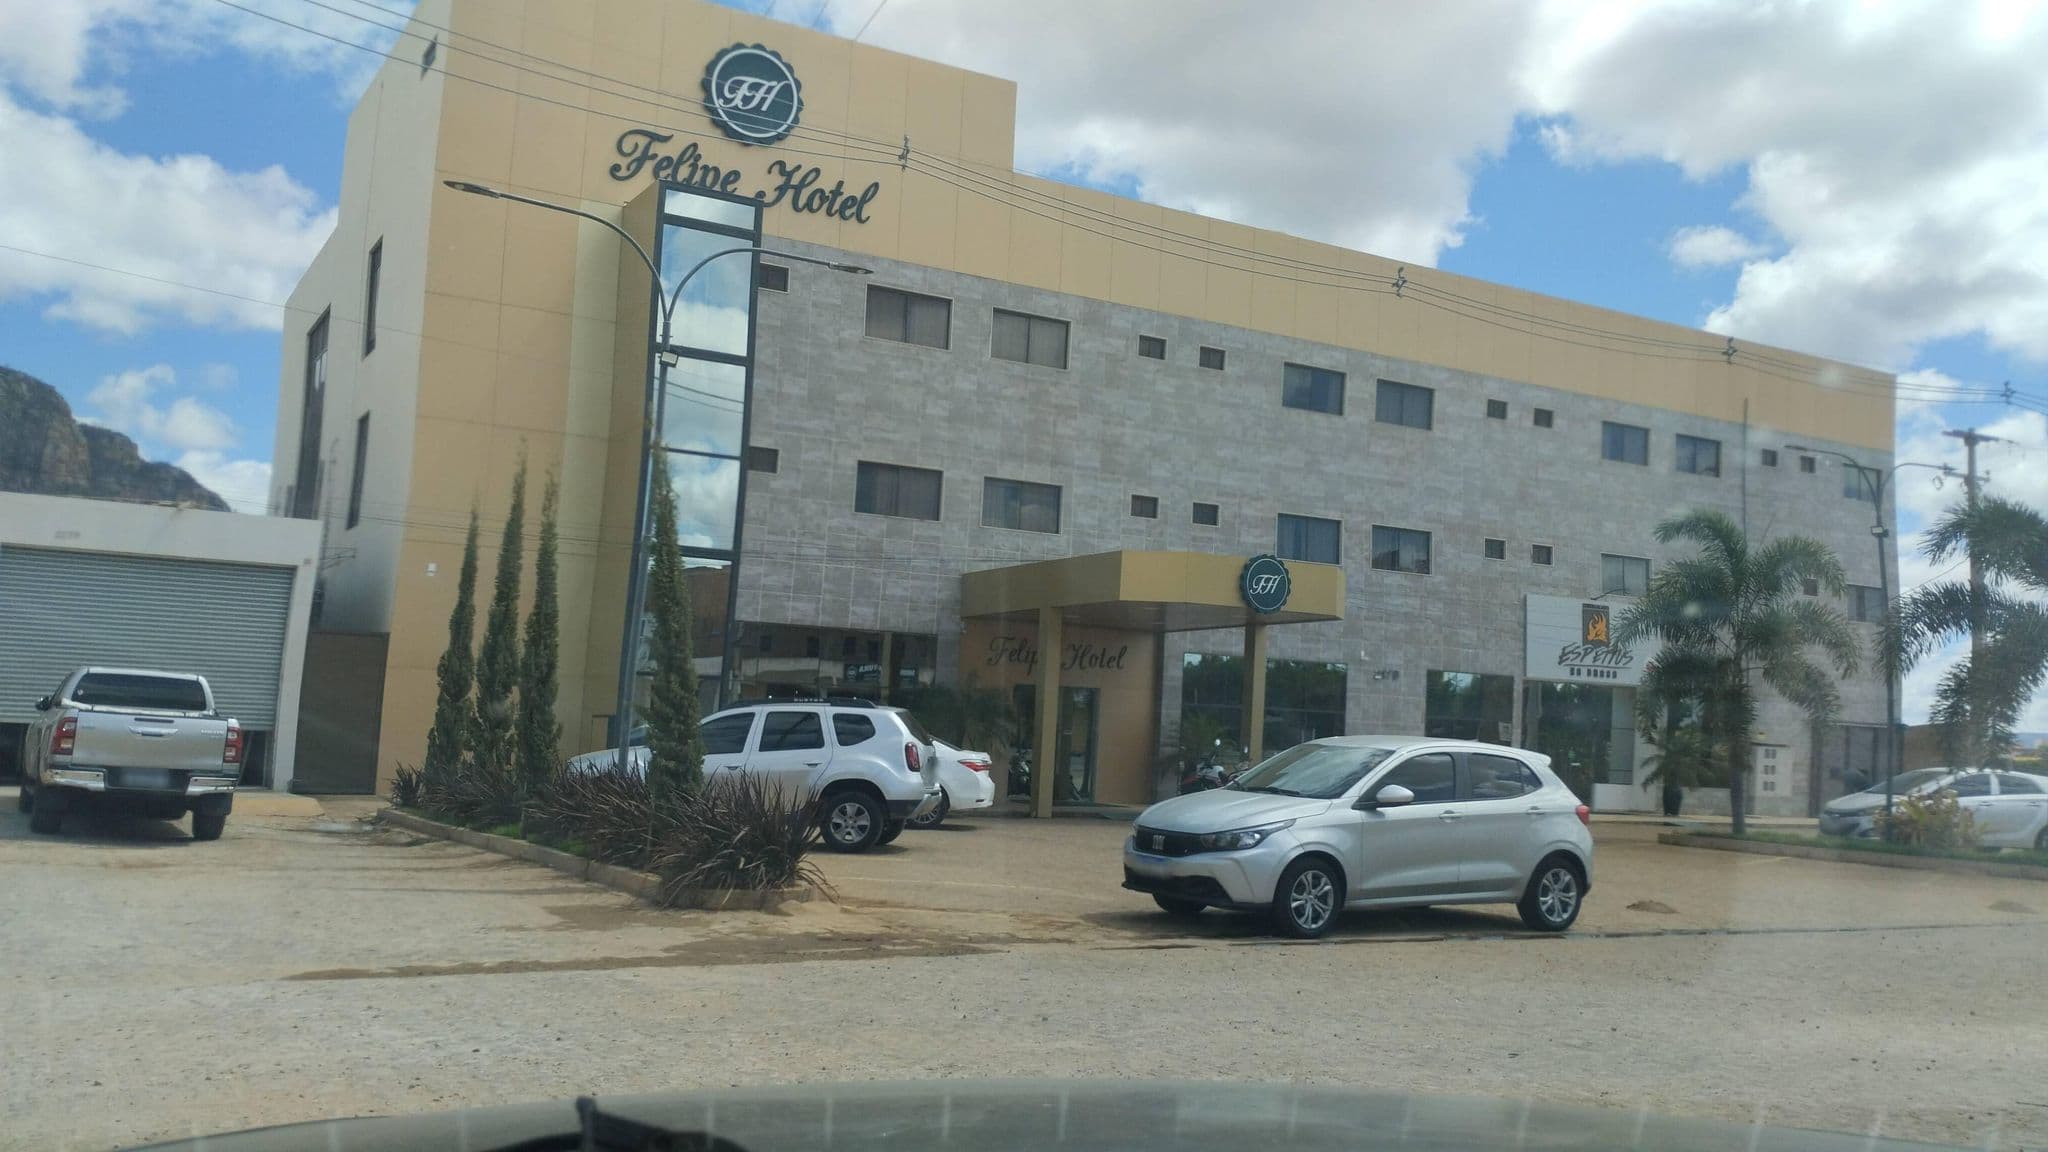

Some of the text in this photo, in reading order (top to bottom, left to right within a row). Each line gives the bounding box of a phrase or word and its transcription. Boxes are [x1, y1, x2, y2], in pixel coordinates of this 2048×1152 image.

[718, 75, 792, 112] FH
[755, 159, 880, 224] Hotel
[1250, 574, 1285, 594] FH
[986, 635, 1128, 676] Felip Hotel
